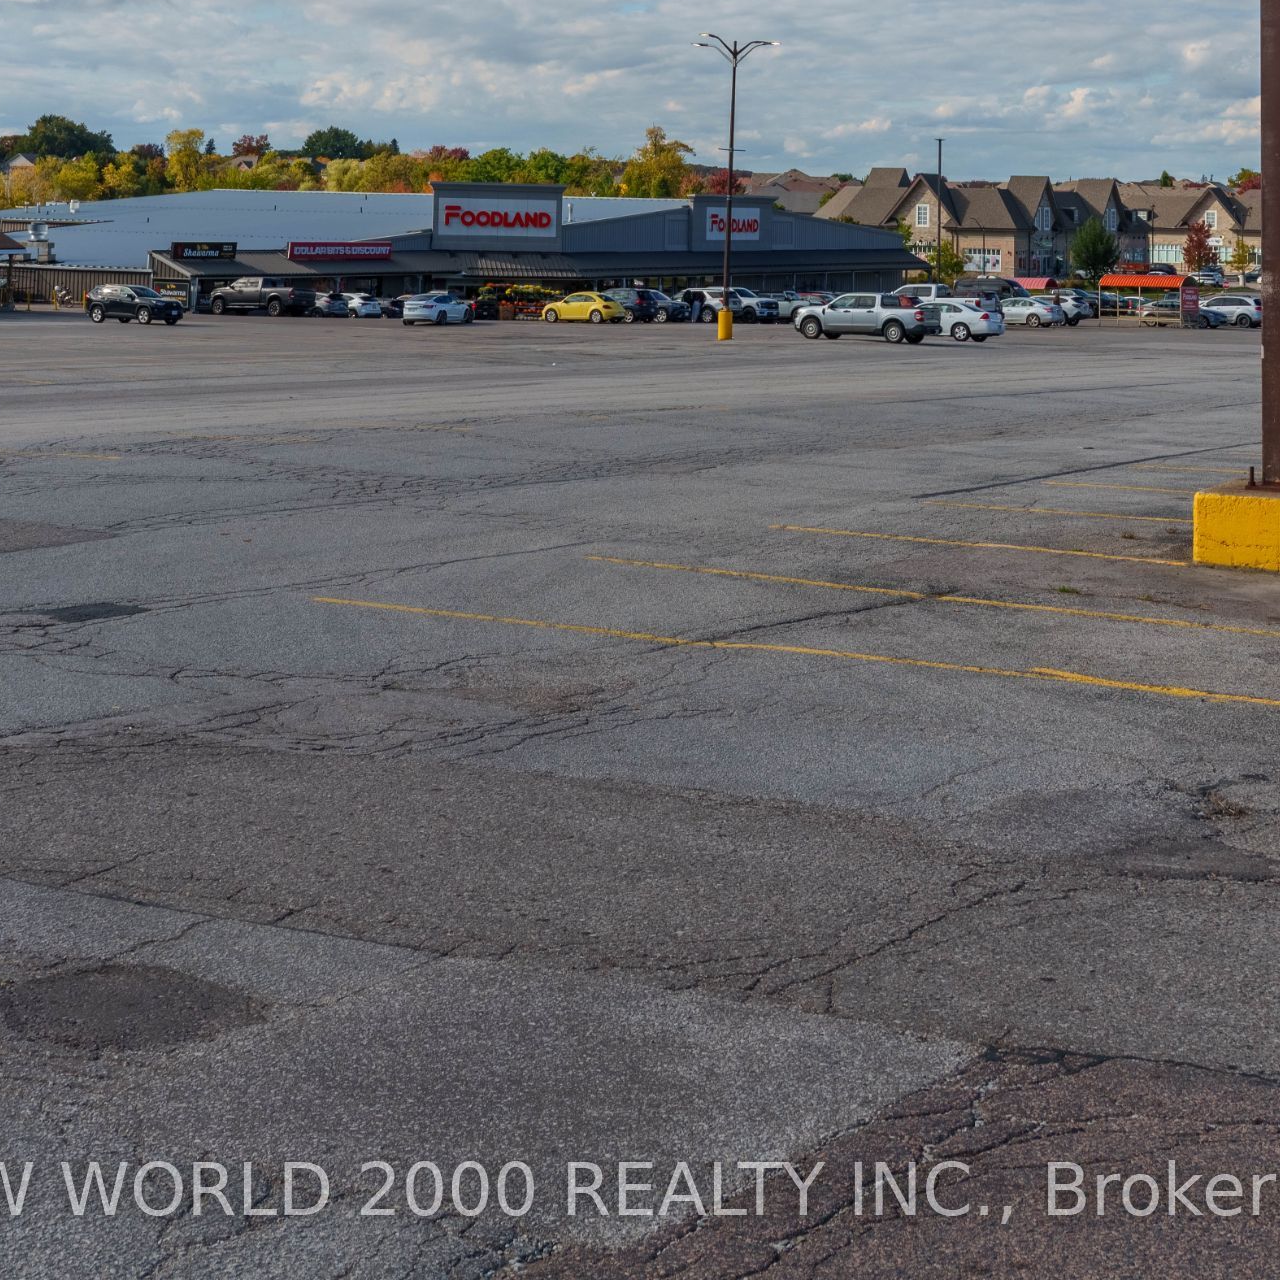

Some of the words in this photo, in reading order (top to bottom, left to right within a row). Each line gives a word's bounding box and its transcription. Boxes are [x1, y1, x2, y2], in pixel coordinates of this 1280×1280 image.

[444, 205, 552, 228] FOODLAND
[710, 214, 759, 233] FODLAND
[183, 248, 220, 257] Shawarma
[293, 246, 326, 255] DOLLAR
[352, 246, 391, 255] DISCOUNT
